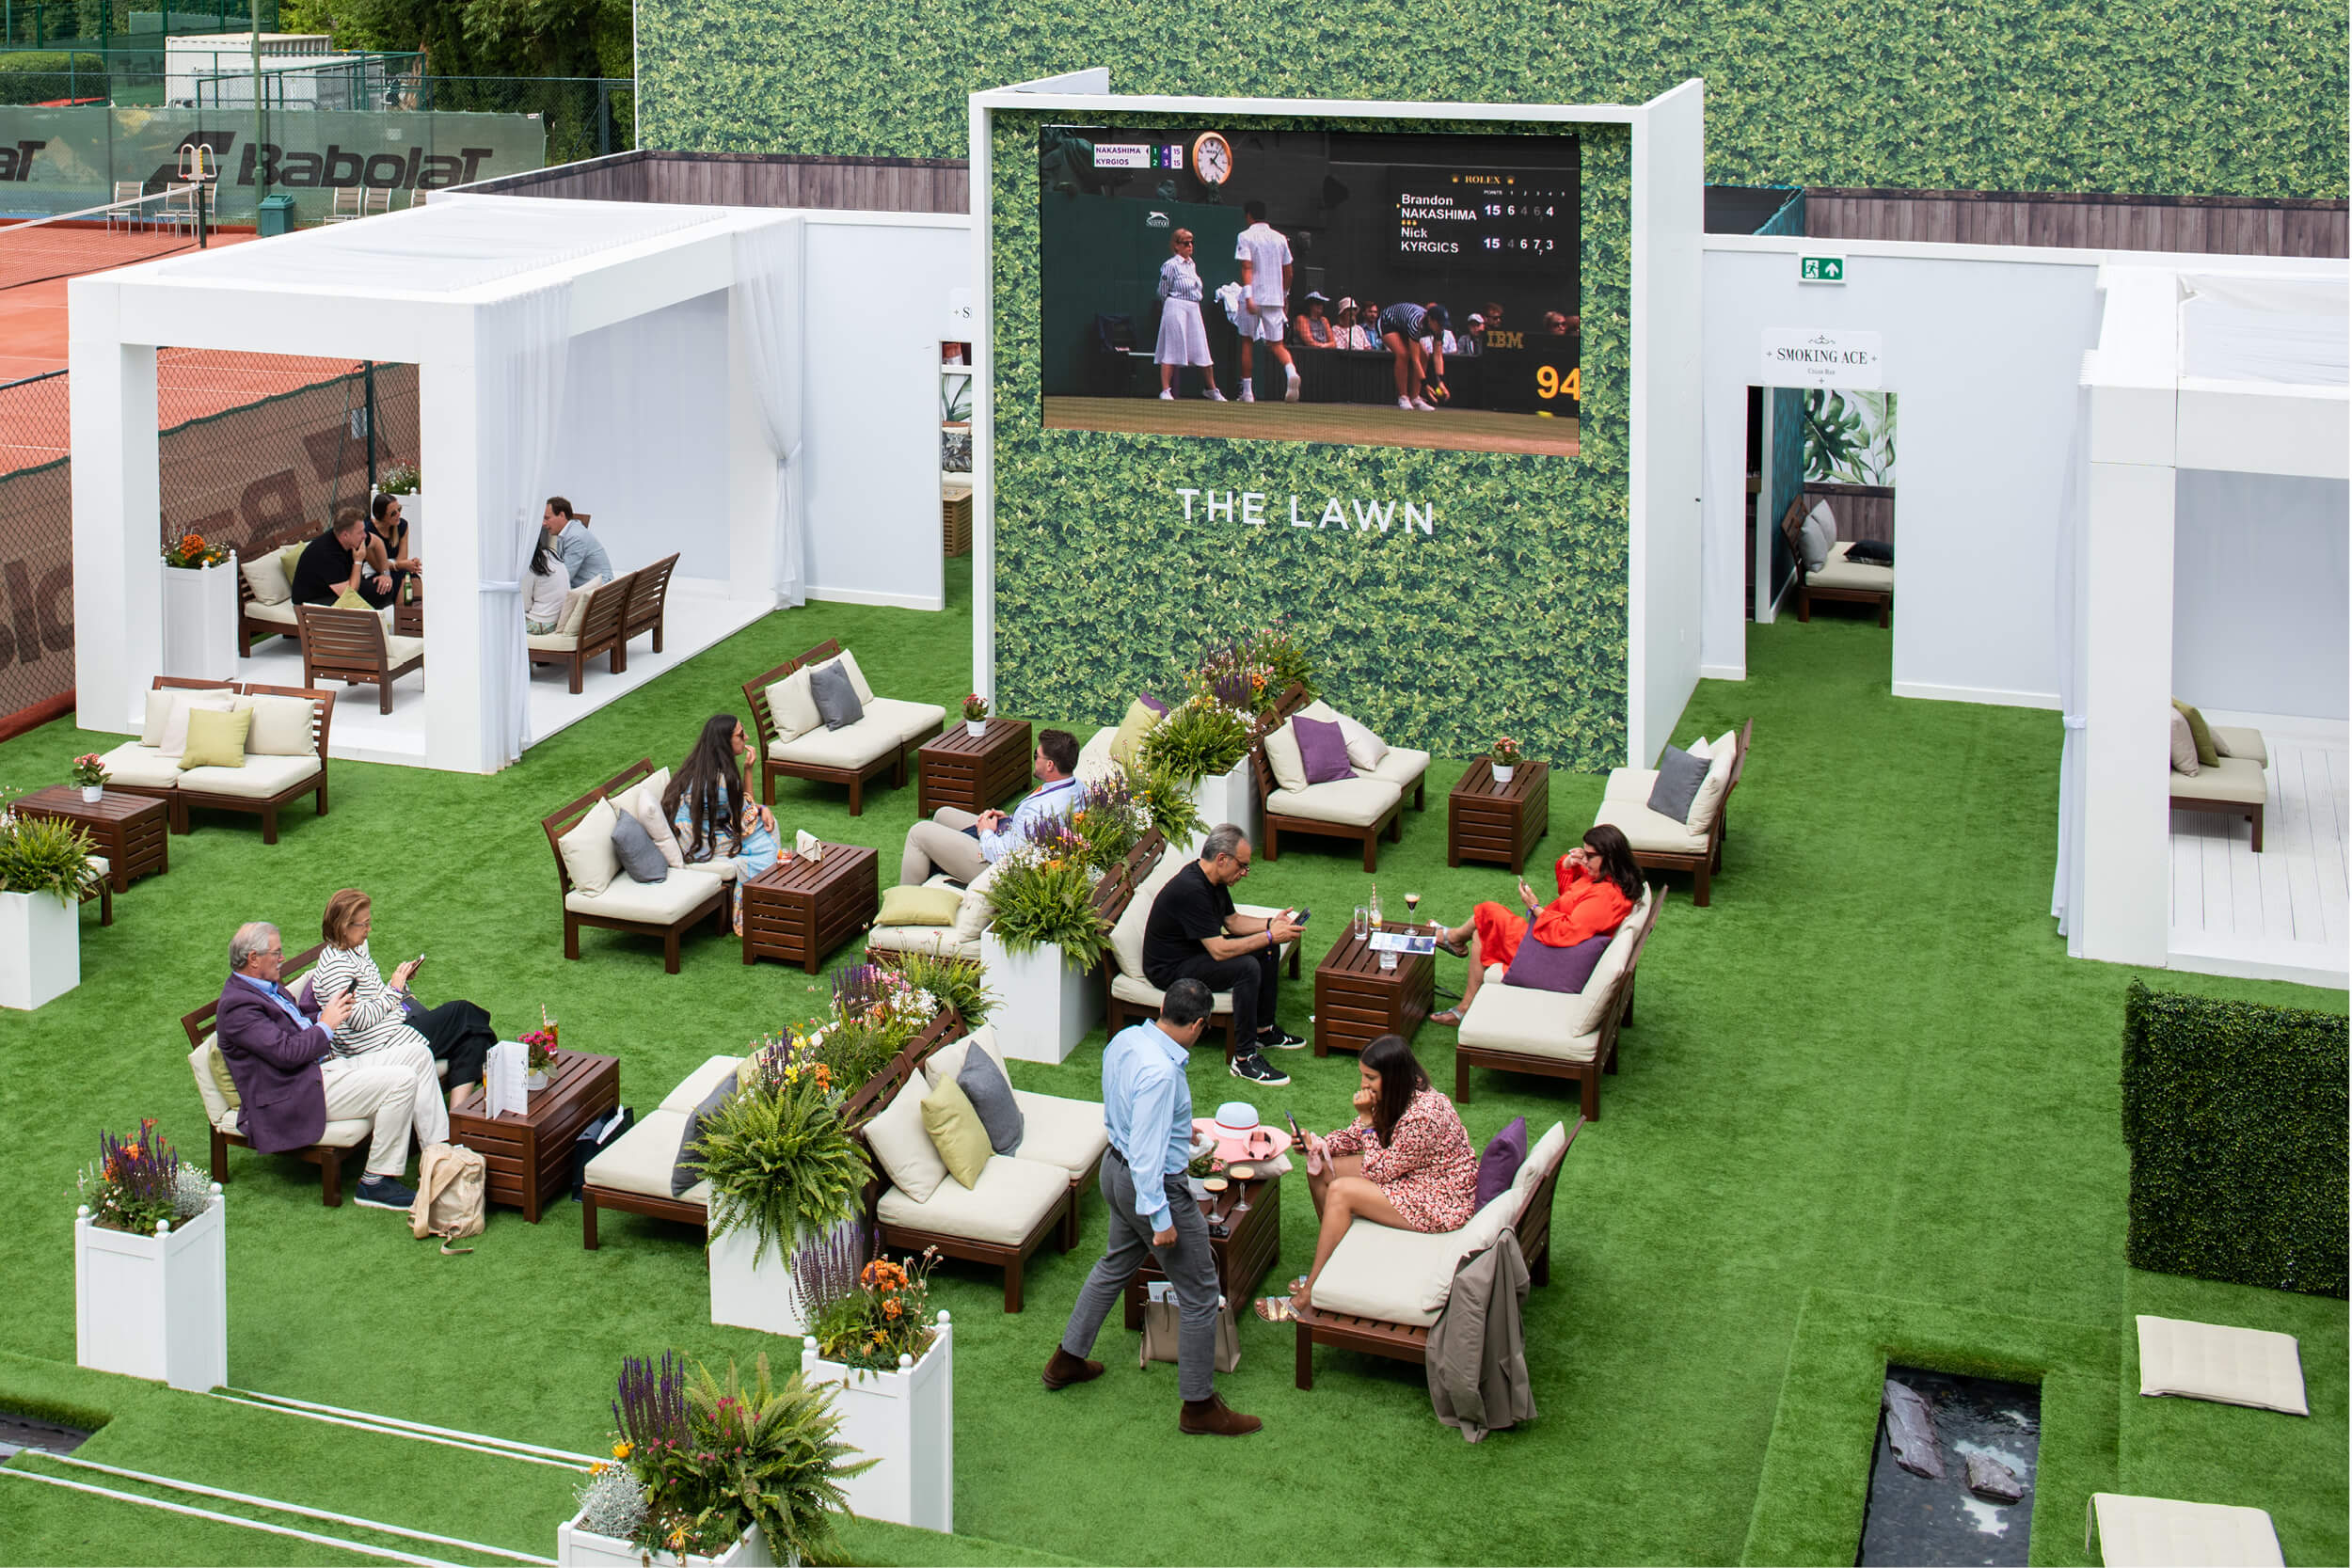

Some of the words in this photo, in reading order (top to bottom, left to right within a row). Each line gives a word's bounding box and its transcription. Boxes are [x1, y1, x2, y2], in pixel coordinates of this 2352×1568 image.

[1465, 175, 1501, 184] ROLEX
[1401, 194, 1454, 206] Brandon
[1401, 207, 1477, 221] NAKASHIMA
[1484, 204, 1502, 215] 15
[1507, 205, 1516, 215] 6
[1520, 205, 1528, 215] 4
[1534, 206, 1541, 216] 6
[1546, 205, 1554, 216] 4
[1401, 227, 1428, 238] Nick
[1484, 237, 1501, 248] 15
[1507, 239, 1514, 248] 4
[1519, 238, 1528, 249] 6
[1534, 239, 1541, 249] 7
[1546, 239, 1554, 250] 3
[1486, 330, 1524, 349] IBM
[1777, 347, 1837, 363] SMOKING
[1841, 351, 1867, 365] ACE
[1536, 365, 1581, 401] 94
[1176, 488, 1266, 525] THE
[1290, 494, 1433, 535] LAWN
